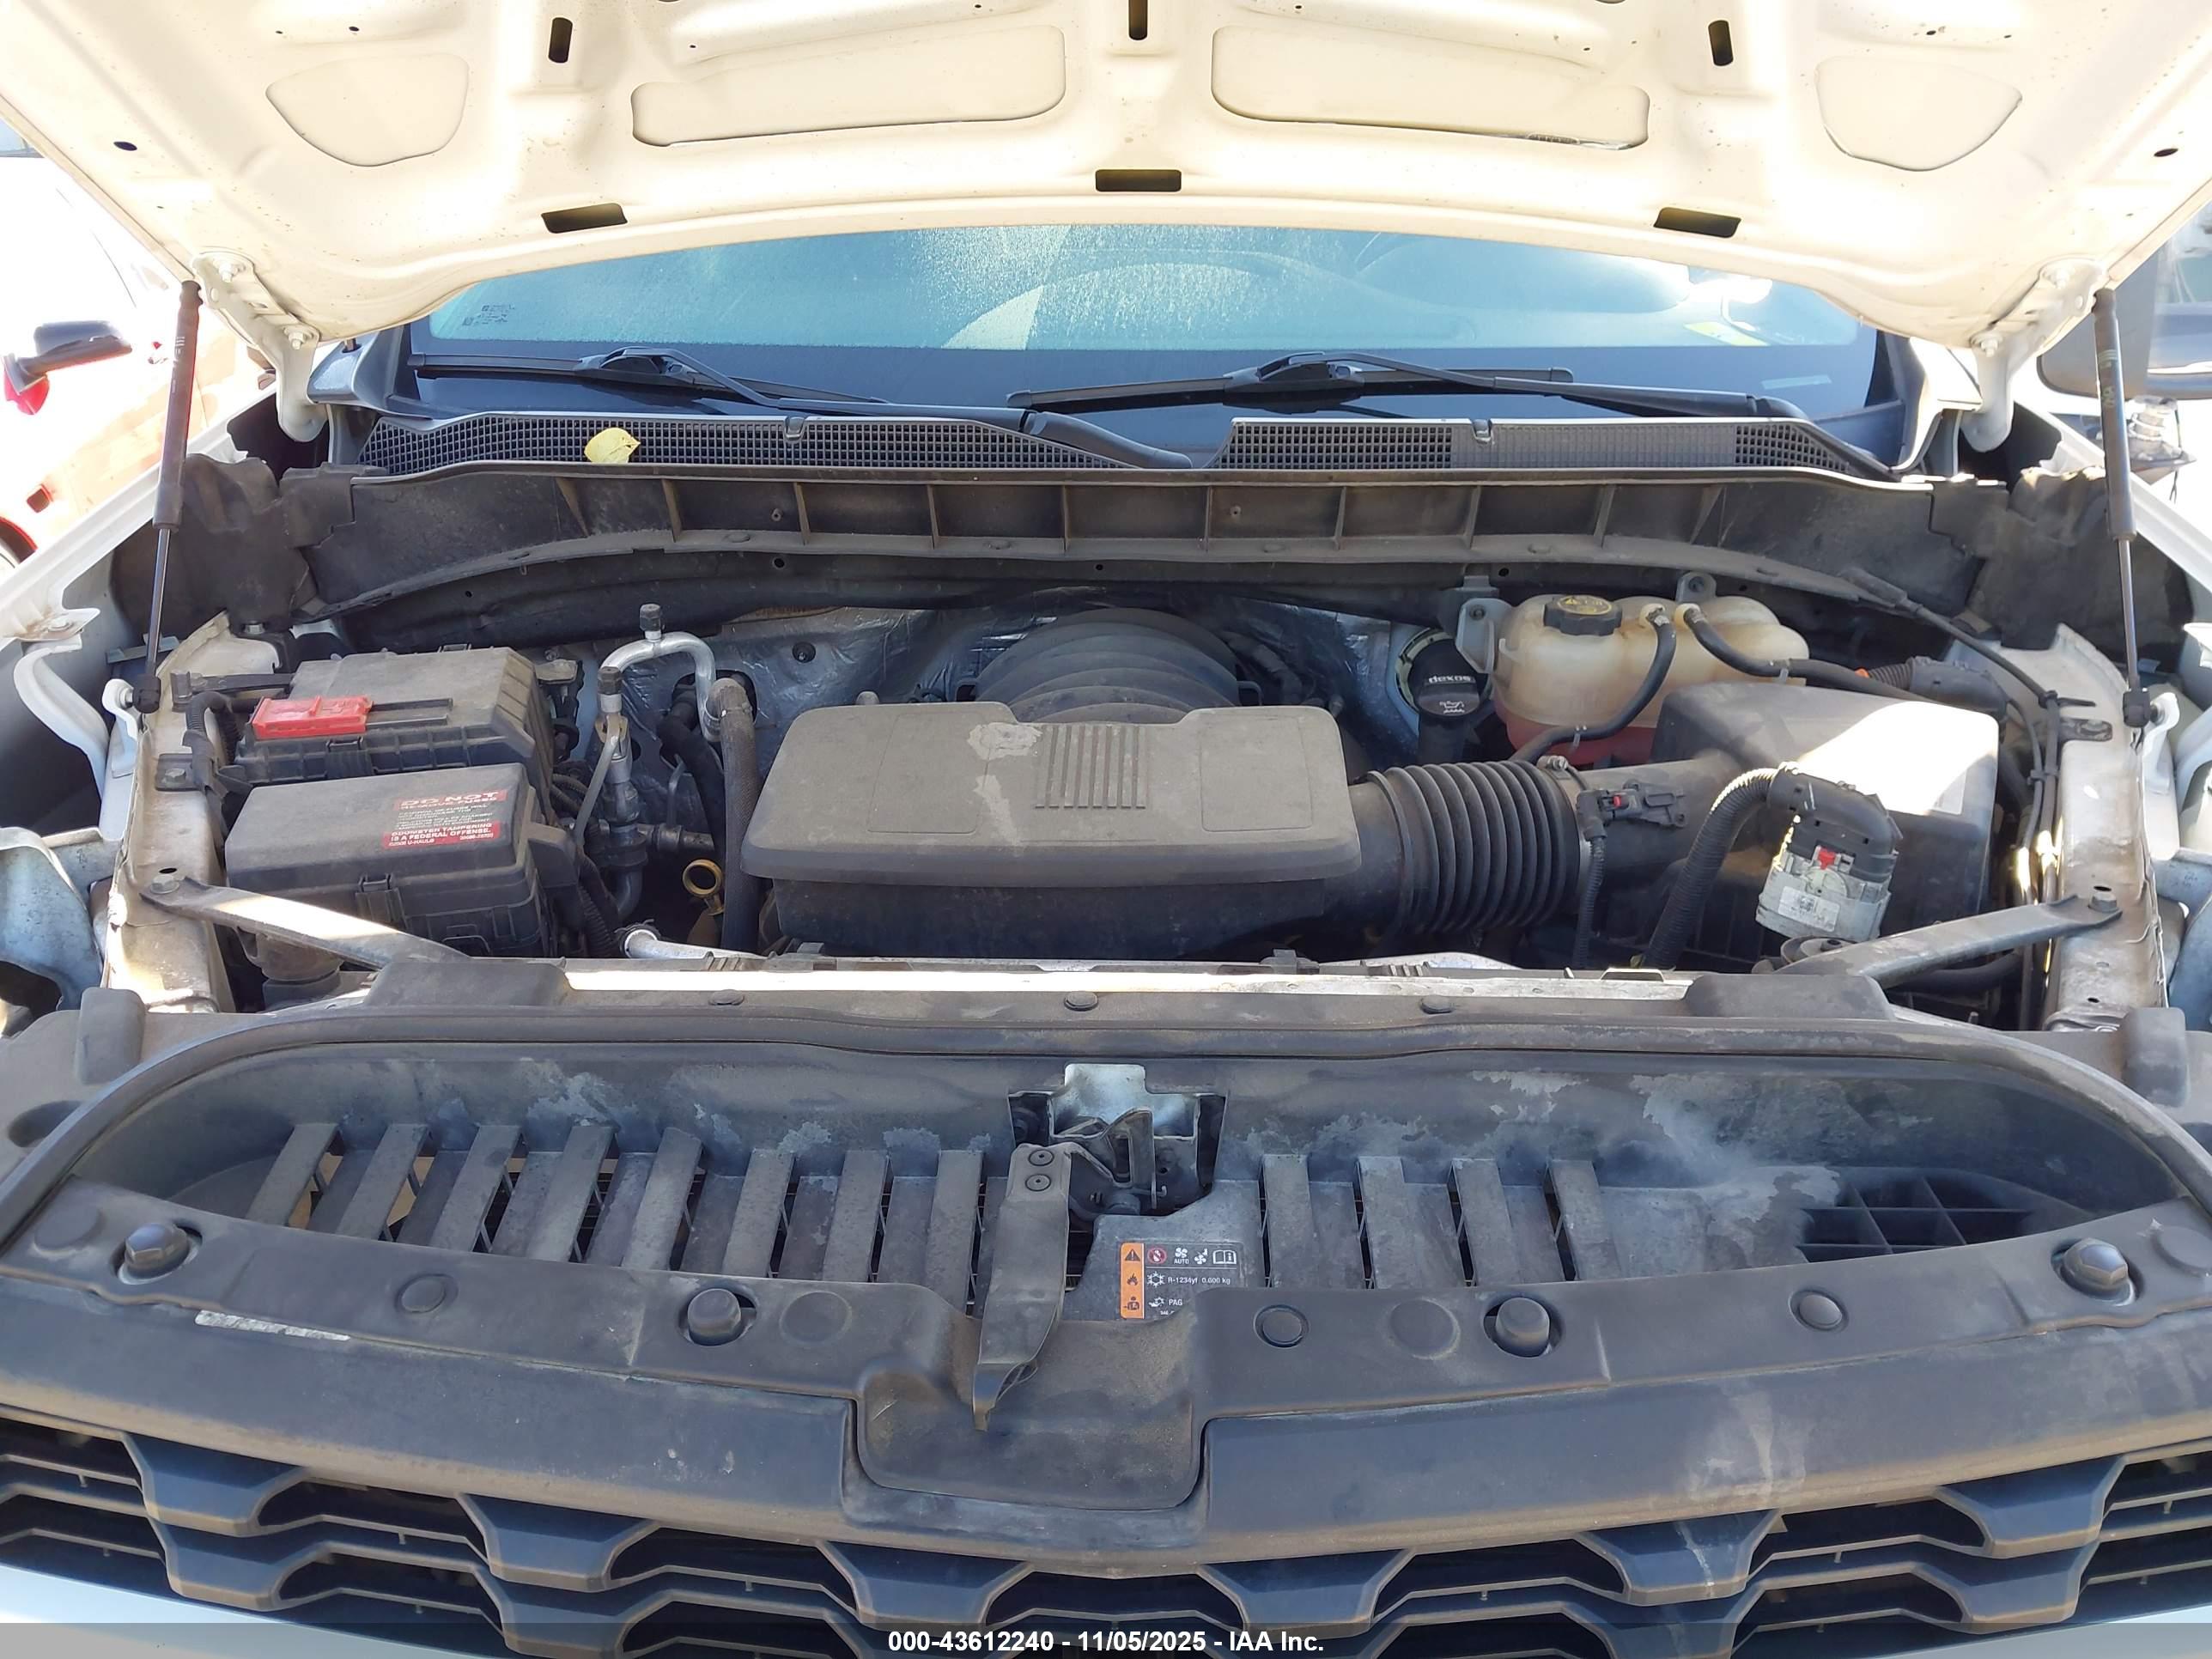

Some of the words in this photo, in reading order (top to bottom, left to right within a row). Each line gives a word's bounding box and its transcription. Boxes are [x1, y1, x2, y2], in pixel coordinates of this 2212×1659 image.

[402, 798, 439, 806] DO
[446, 792, 498, 801] NOT
[392, 828, 441, 836] ODOMETER
[442, 823, 492, 832] TAMPERING
[409, 830, 447, 840] FEDERAL
[449, 828, 491, 836] OFFENSE.
